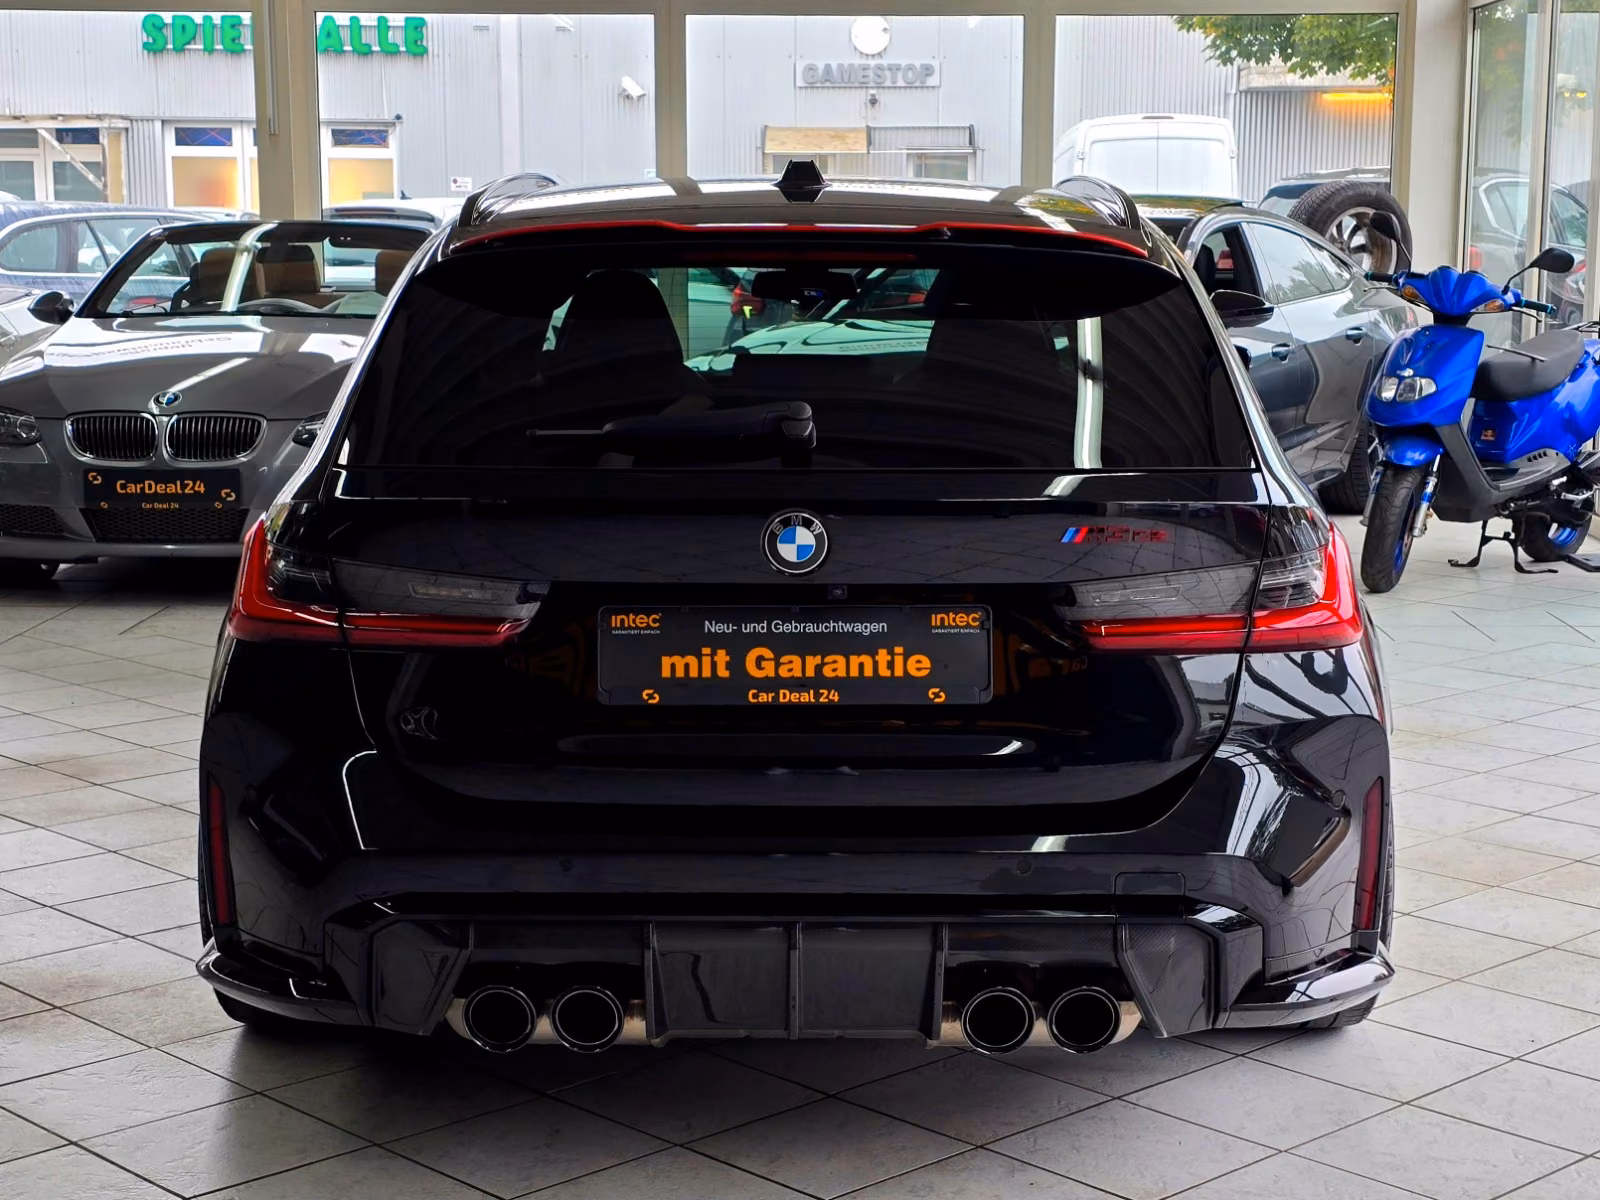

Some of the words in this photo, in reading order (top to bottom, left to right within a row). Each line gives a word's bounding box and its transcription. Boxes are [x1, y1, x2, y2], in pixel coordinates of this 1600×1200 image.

[142, 14, 428, 55] SPIEALLE
[802, 63, 935, 85] GAMESTOP
[611, 613, 660, 628] intec
[704, 620, 738, 634] Neu-
[741, 620, 767, 634] und
[771, 619, 888, 636] Gebrauchtwagen
[931, 611, 980, 627] intec
[661, 647, 731, 679] mit
[745, 646, 932, 679] Garantie
[747, 689, 775, 703] Car
[779, 689, 816, 703] Deal
[818, 689, 840, 703] 24
